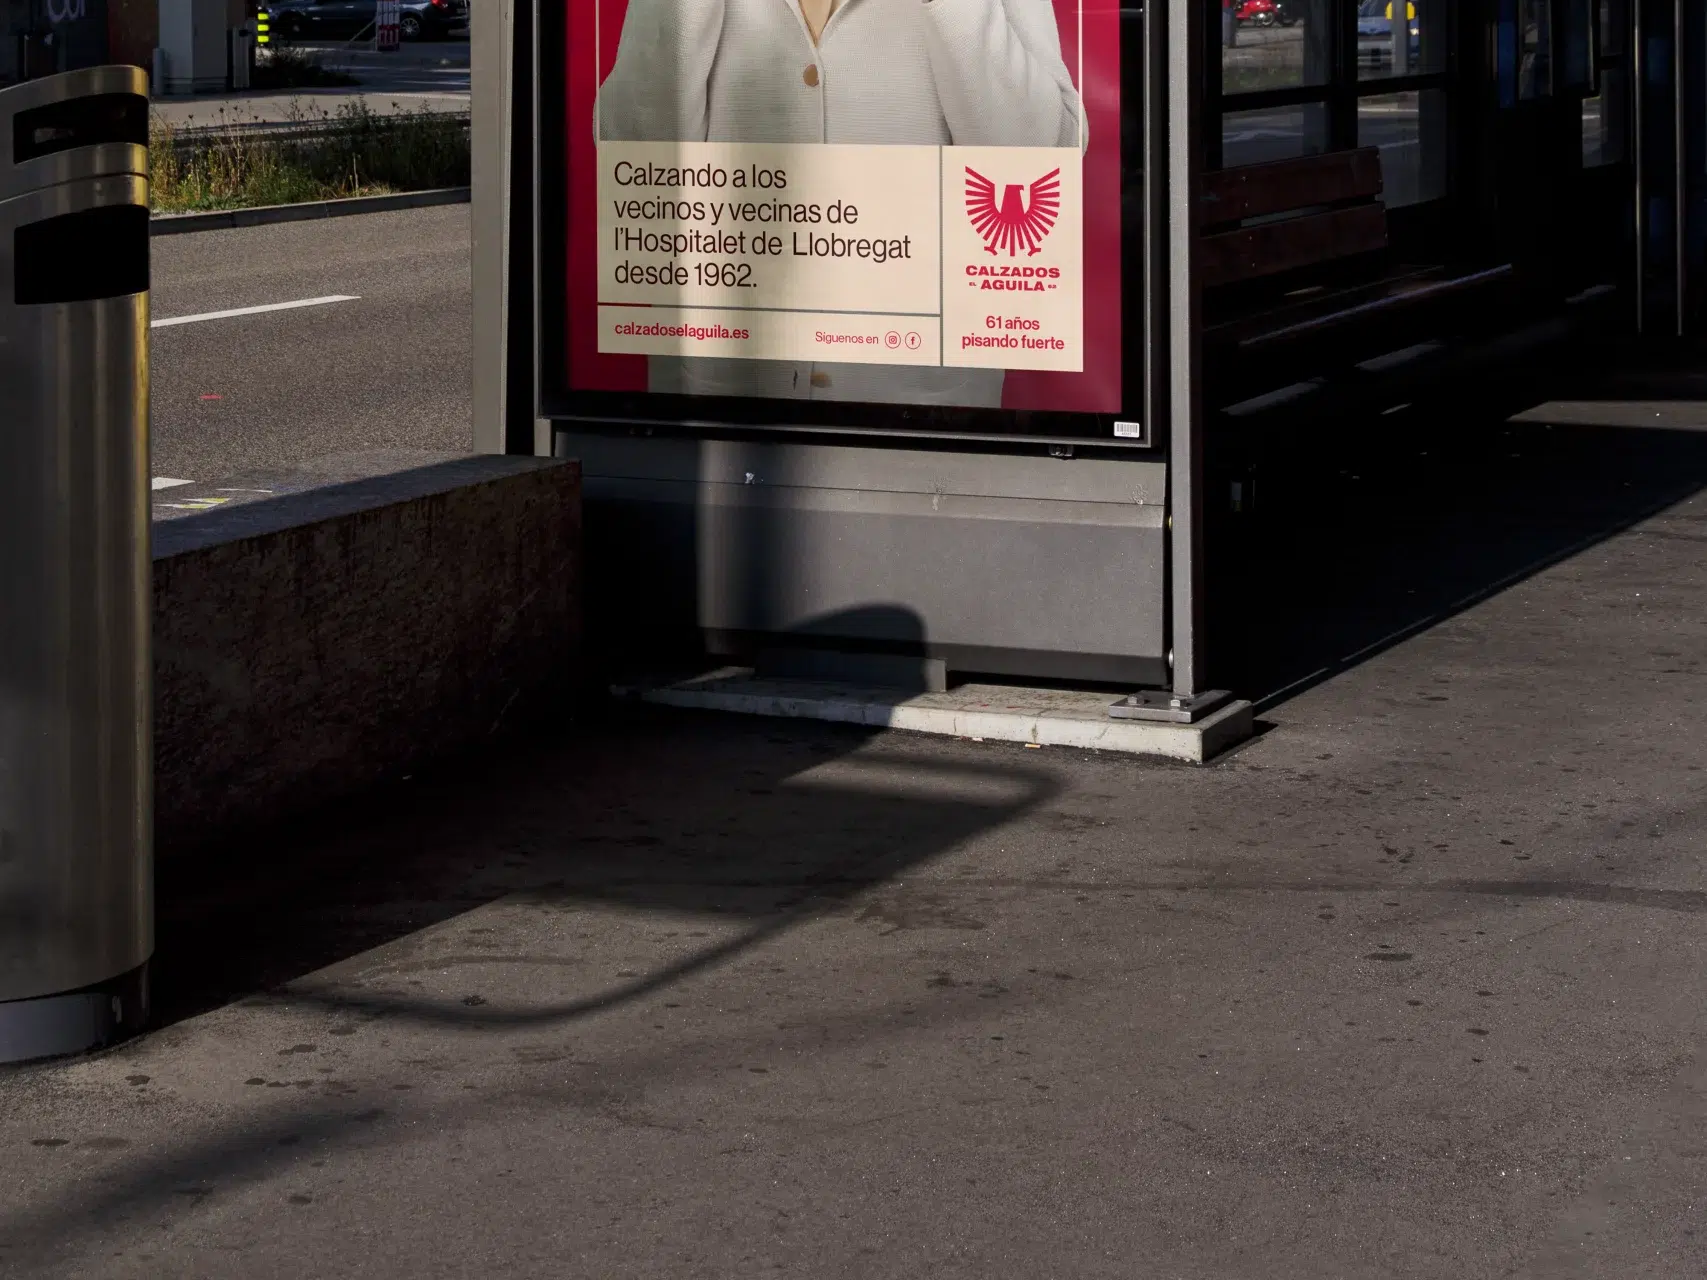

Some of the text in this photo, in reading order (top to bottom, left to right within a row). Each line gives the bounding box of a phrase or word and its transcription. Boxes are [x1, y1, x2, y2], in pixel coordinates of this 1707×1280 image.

[614, 160, 787, 189] Calzando a los
[614, 196, 859, 225] vecinos y vecinas de
[614, 227, 911, 263] l'Hospitalet de Llobregat
[614, 259, 758, 287] desde 1962.
[965, 265, 1060, 278] CALZADOS
[980, 279, 1045, 292] AGUILA
[614, 322, 750, 340] calzadoselaguila.es
[986, 316, 1041, 330] 61 años
[865, 336, 879, 344] en
[962, 333, 1064, 350] pisando fuerte
